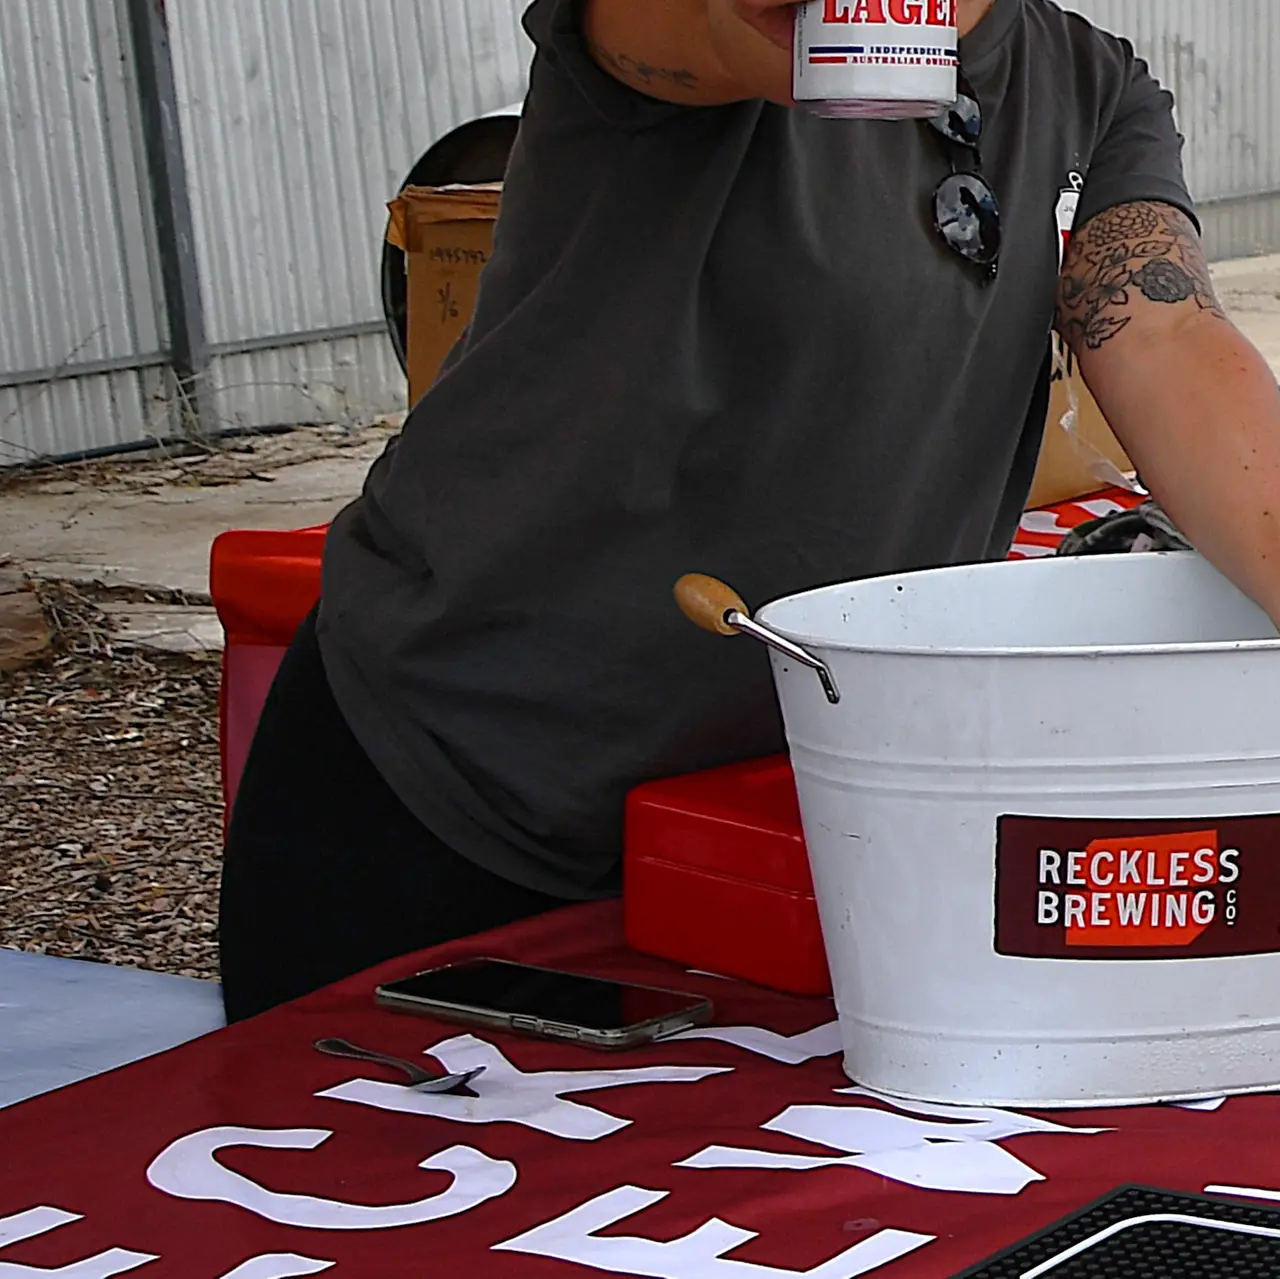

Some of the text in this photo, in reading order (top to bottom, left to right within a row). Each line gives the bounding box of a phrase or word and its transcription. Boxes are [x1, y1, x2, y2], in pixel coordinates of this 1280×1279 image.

[852, 56, 922, 65] AUSTRALIAN
[870, 46, 942, 56] INDEPENDENT
[1038, 848, 1241, 886] RECKLESS
[1037, 890, 1216, 929] BREWING
